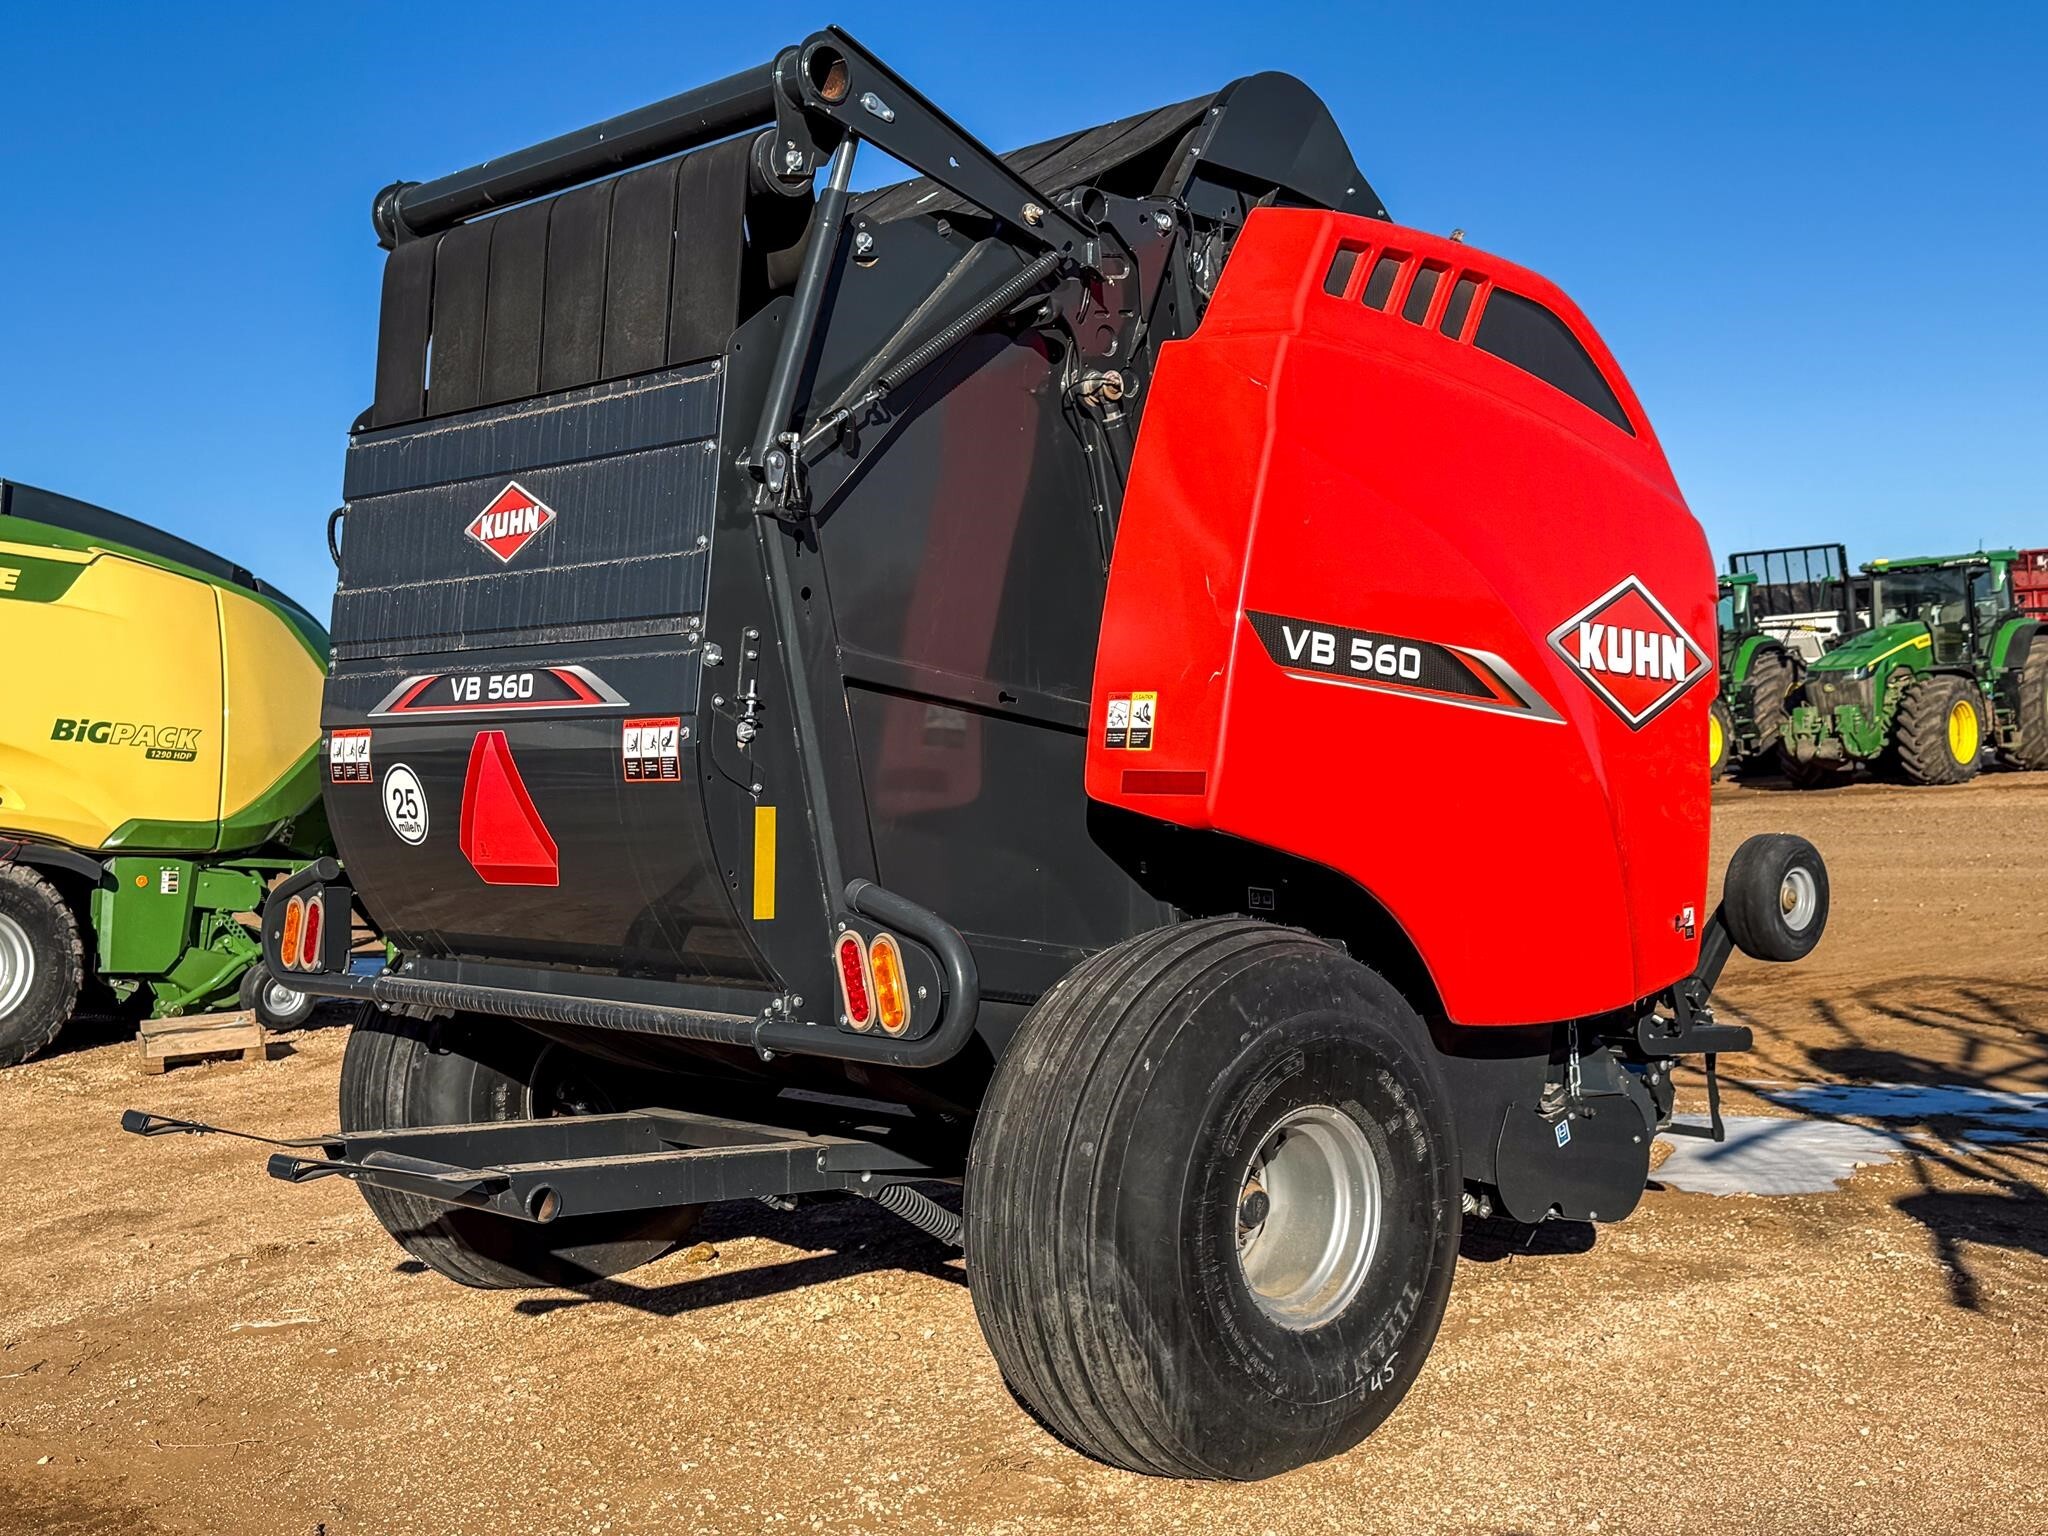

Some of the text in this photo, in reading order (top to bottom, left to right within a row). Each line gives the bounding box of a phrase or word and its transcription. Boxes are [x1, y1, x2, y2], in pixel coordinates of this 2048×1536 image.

[480, 505, 540, 541] KUHN
[1282, 625, 1421, 680] VB 560
[1579, 620, 1685, 682] KUHN
[450, 673, 534, 702] VB 560
[50, 718, 203, 750] BiGPACK
[150, 750, 193, 760] 1290 HDP
[392, 788, 418, 820] 25
[398, 821, 423, 833] mile/h
[1371, 1351, 1399, 1392] 45
